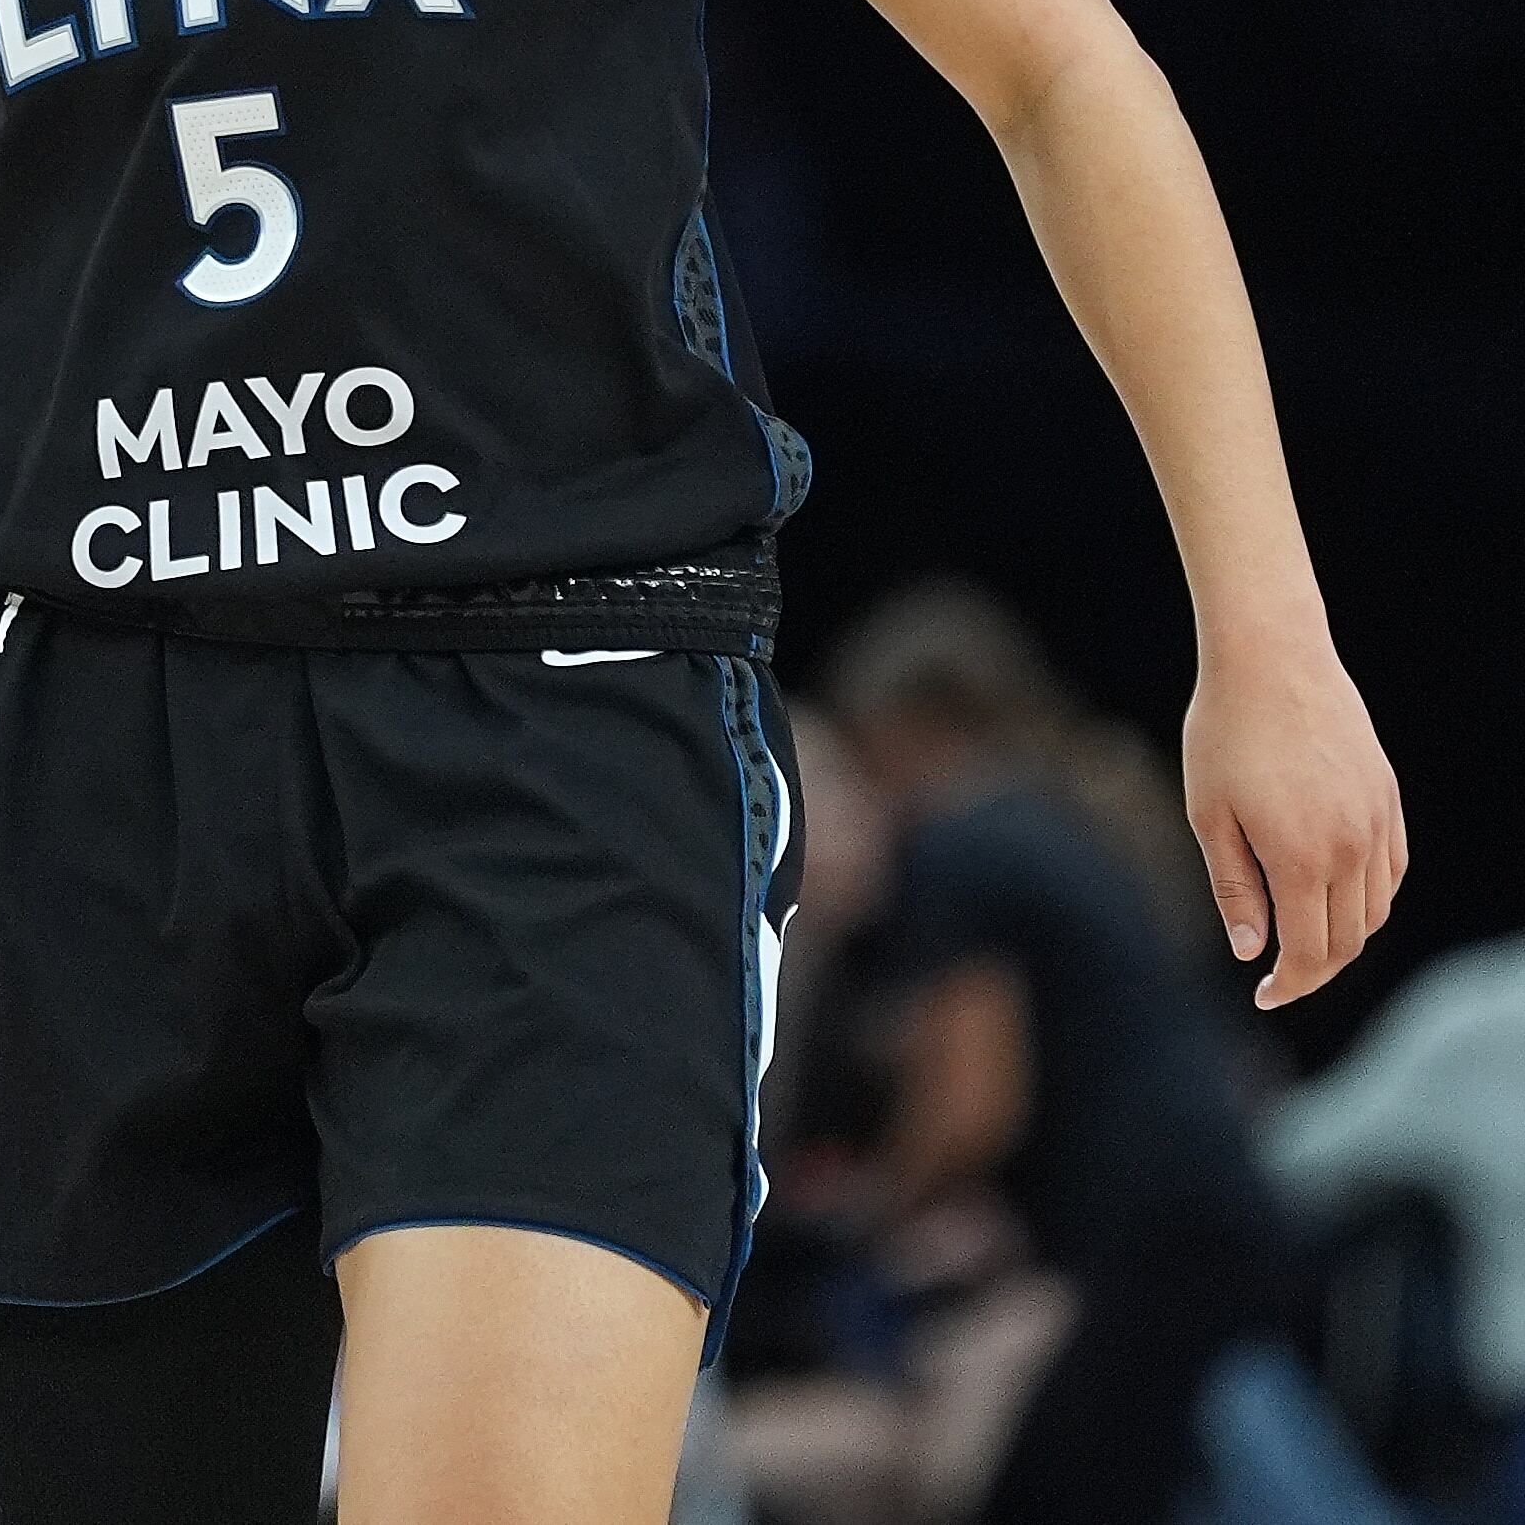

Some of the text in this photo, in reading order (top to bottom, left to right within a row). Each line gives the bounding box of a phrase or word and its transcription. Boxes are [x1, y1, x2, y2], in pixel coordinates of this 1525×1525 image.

[167, 86, 303, 308] 5
[96, 366, 415, 480] MAYO
[71, 463, 468, 589] CLINIC
